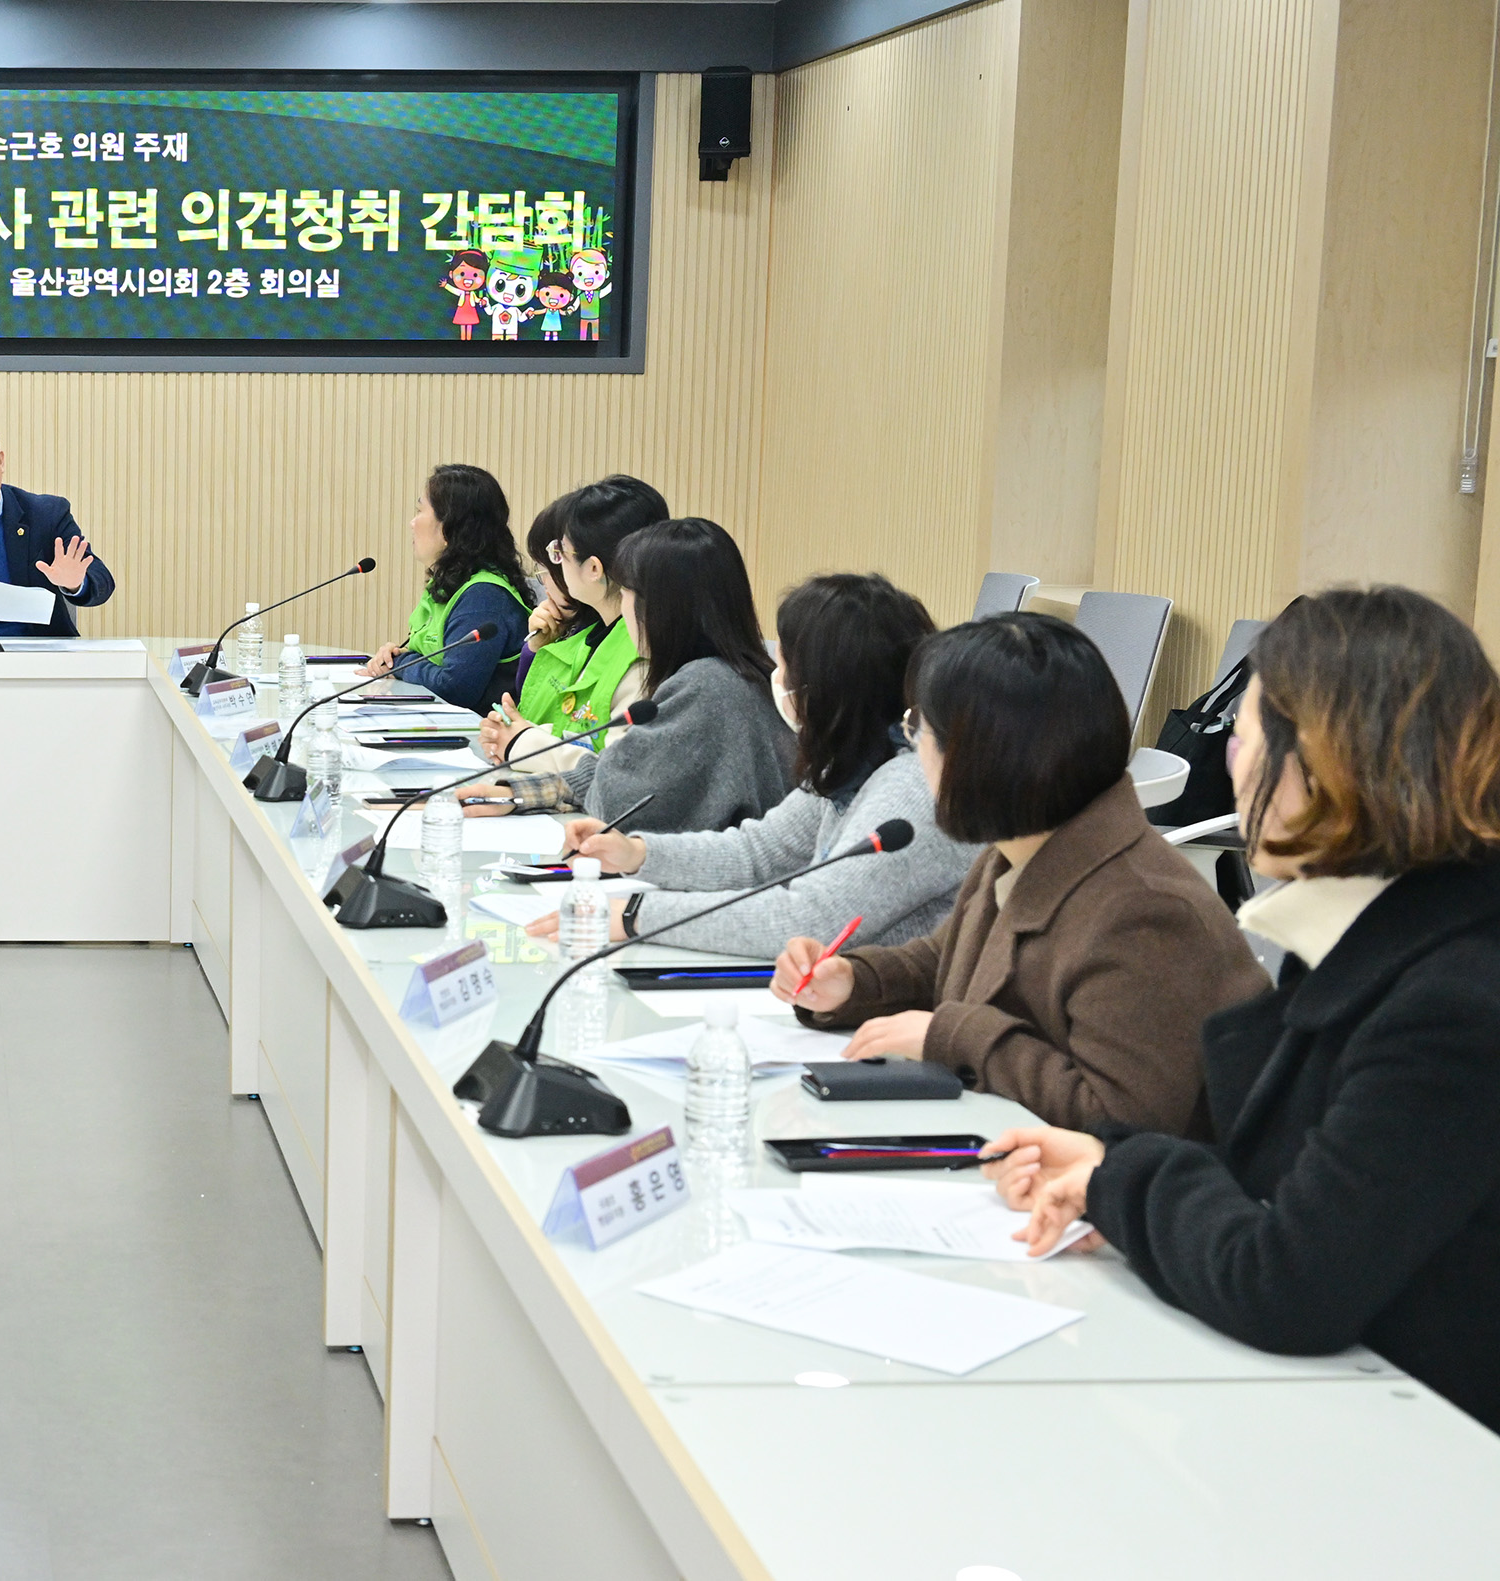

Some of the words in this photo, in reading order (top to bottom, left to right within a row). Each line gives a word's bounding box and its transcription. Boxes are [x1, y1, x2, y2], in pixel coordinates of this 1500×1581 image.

[71, 132, 125, 161] 의원
[133, 132, 188, 162] 주재
[48, 188, 159, 250] 관련
[177, 189, 402, 252] 의견청취
[420, 190, 586, 253] 간담회
[9, 266, 198, 298] 울산광역시의회
[206, 268, 251, 298] 2층
[259, 268, 340, 298] 회의실
